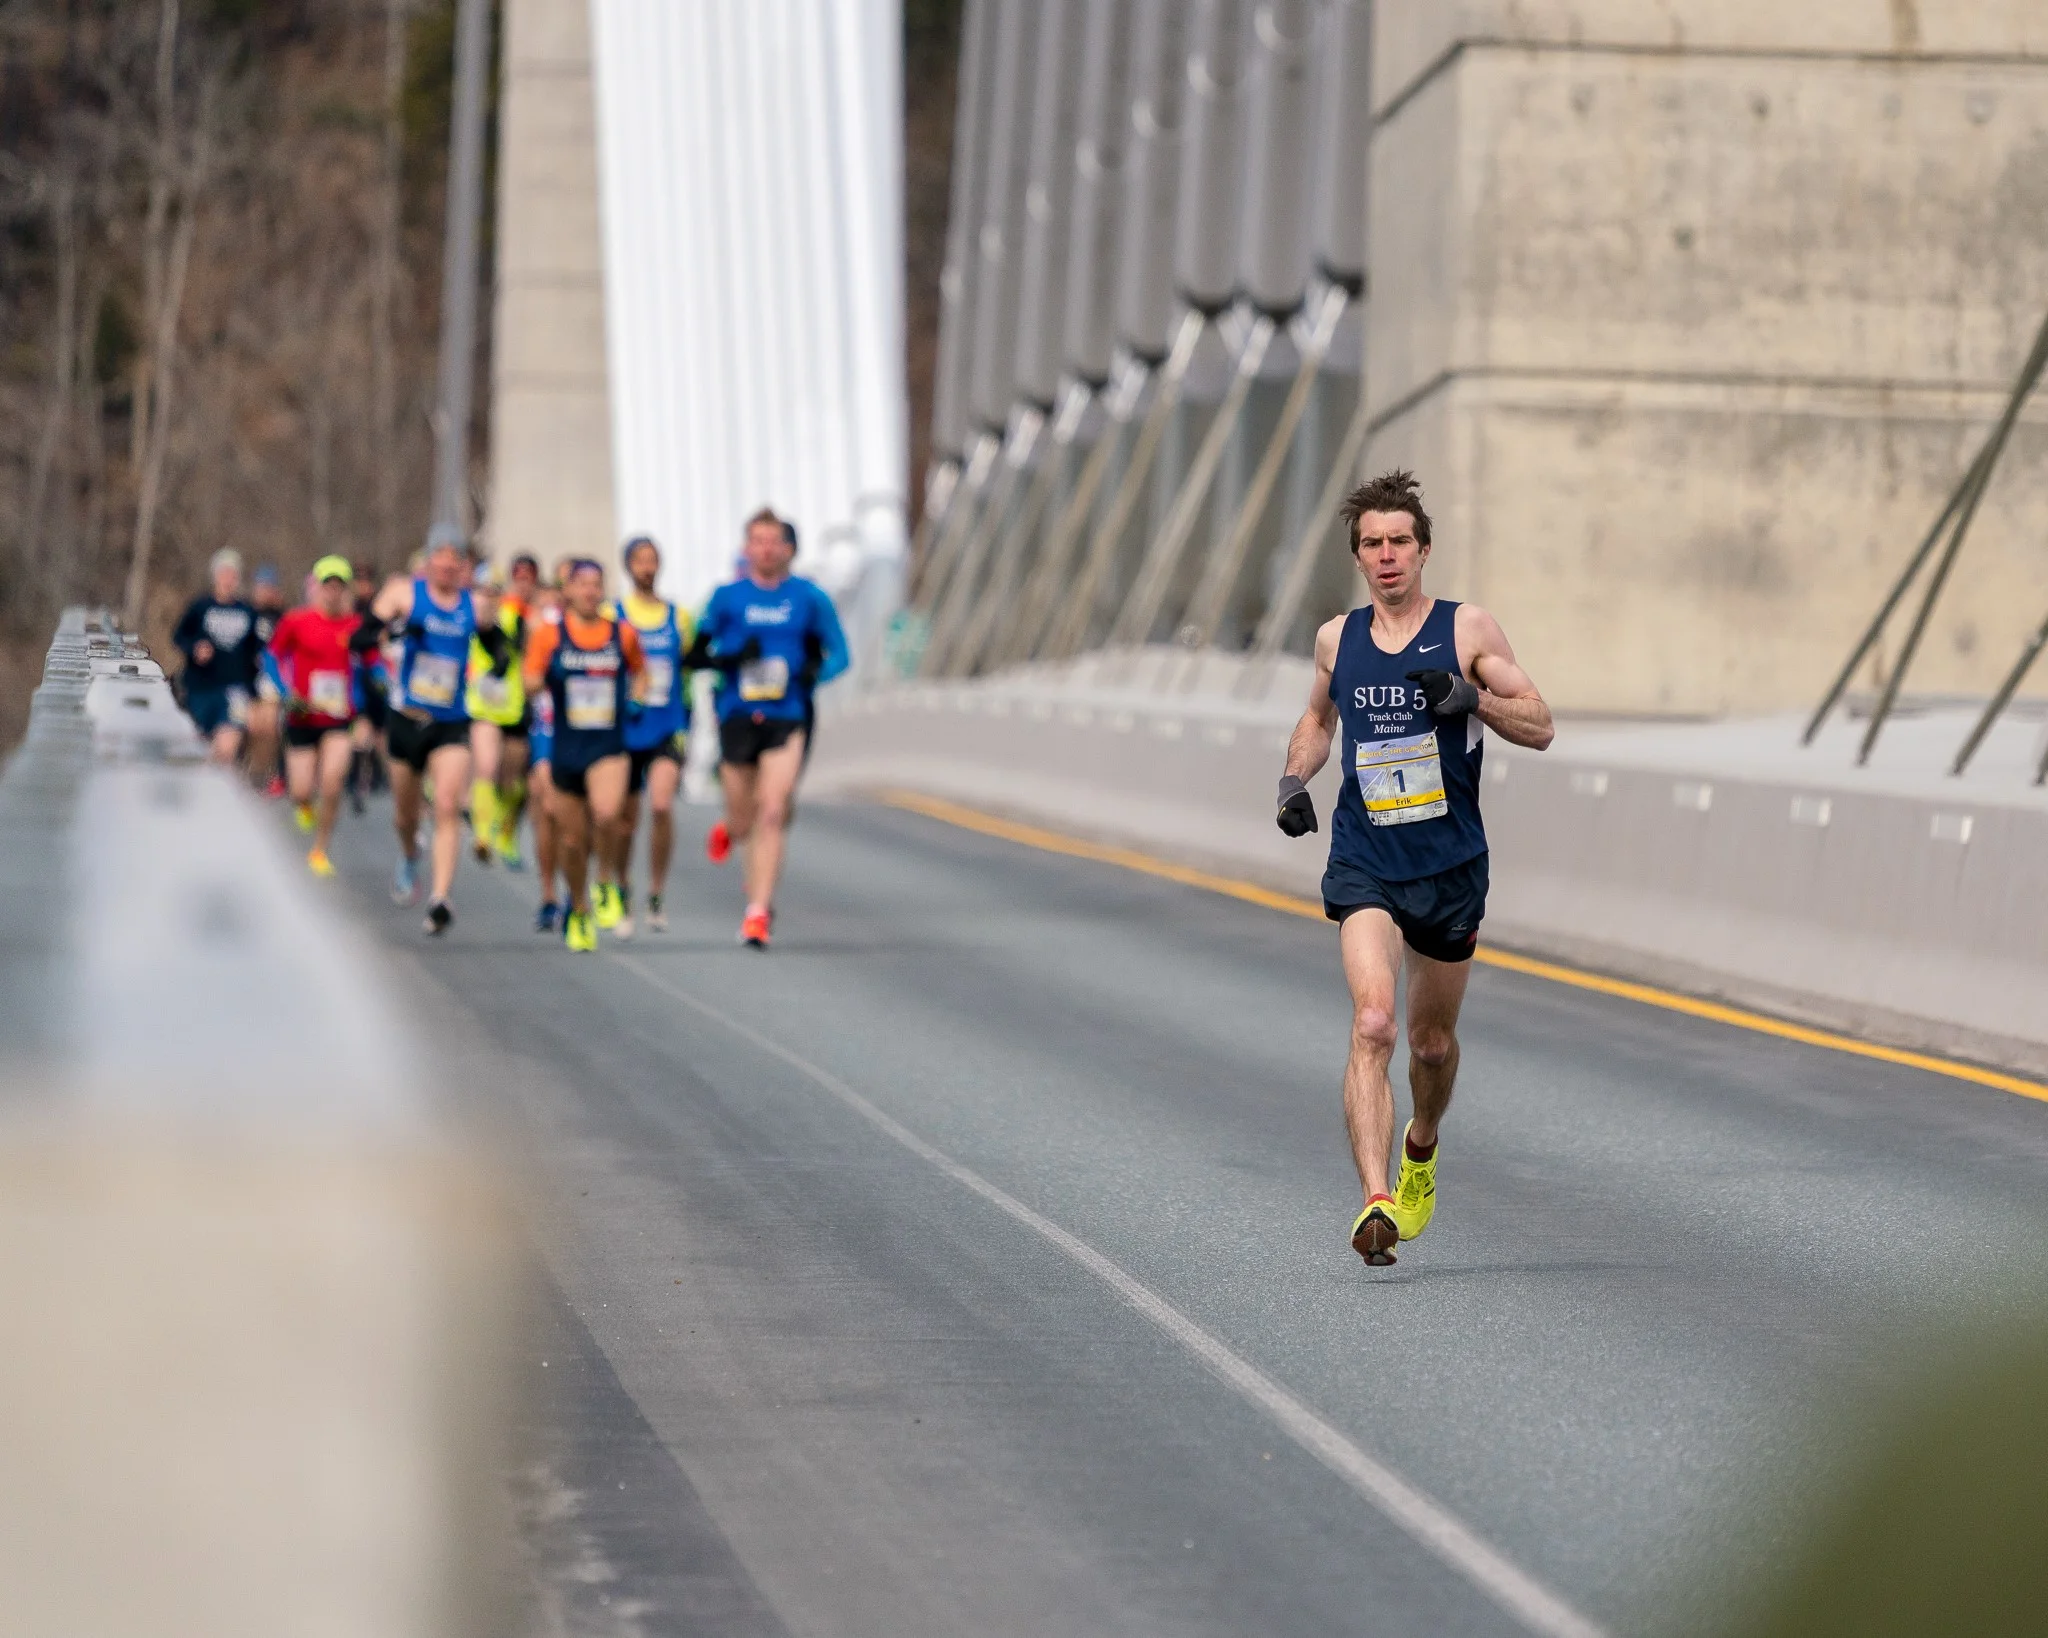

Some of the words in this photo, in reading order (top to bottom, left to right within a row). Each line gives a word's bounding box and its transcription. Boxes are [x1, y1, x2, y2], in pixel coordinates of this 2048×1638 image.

[1354, 686, 1406, 709] SUB
[1412, 689, 1427, 711] 5
[1368, 712, 1392, 722] Track
[1392, 711, 1413, 721] Club
[1373, 724, 1406, 734] Maine
[1392, 769, 1406, 793] 1
[1395, 798, 1412, 807] Erik
